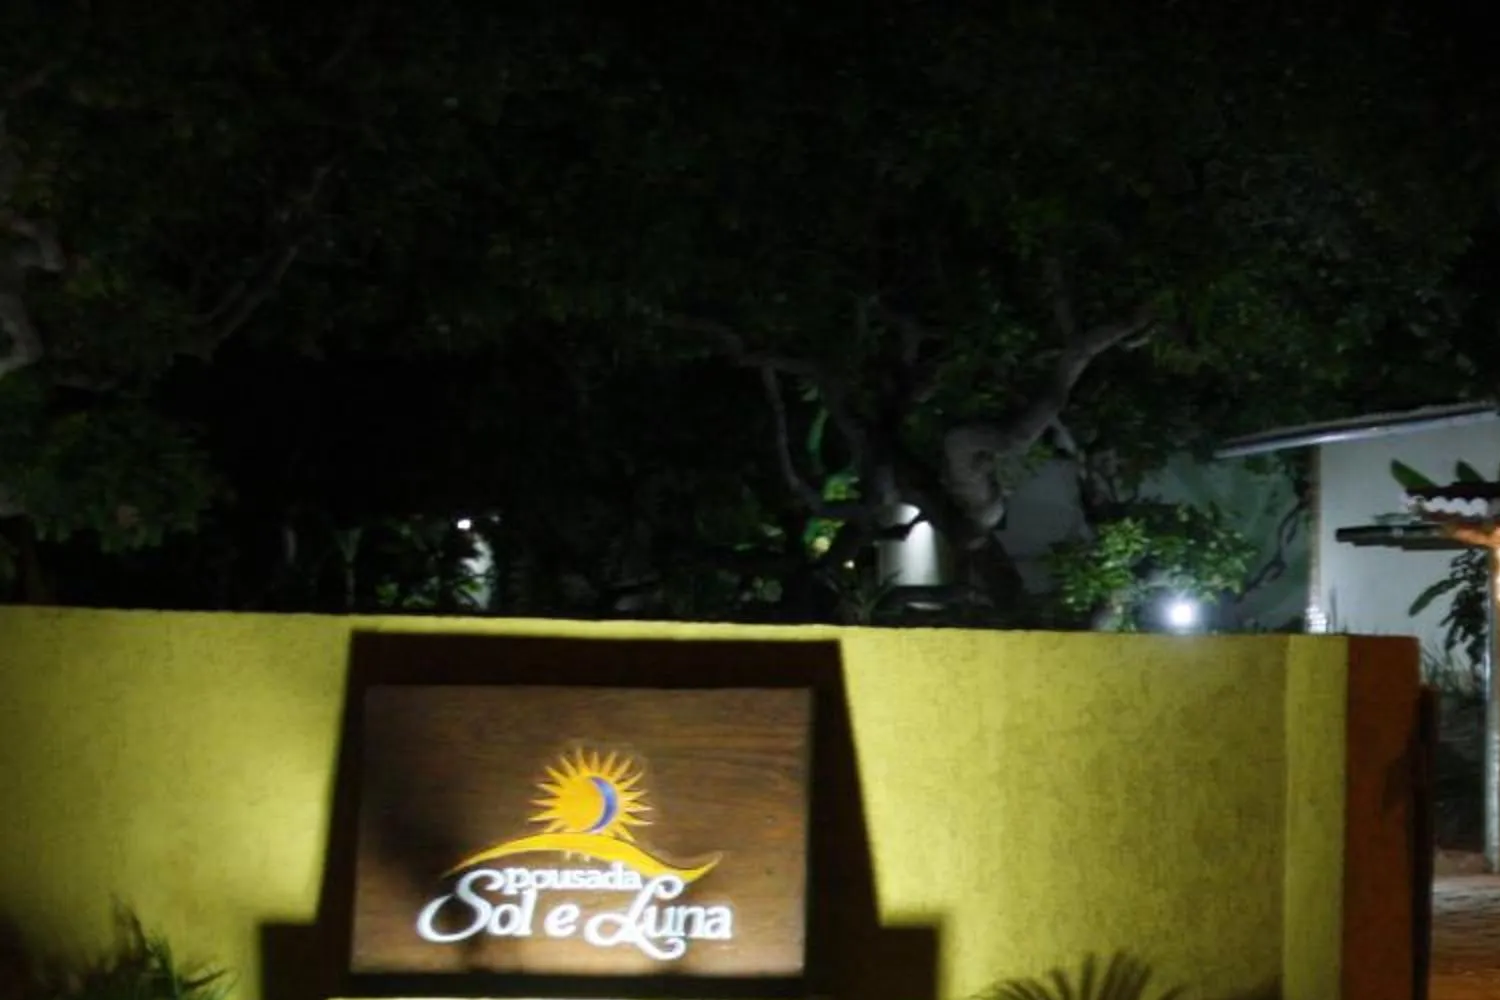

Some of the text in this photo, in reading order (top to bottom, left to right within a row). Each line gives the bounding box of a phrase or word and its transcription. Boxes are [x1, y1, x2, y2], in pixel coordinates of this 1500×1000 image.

[501, 862, 643, 894] pousada
[416, 868, 732, 961] Sol e Luna
